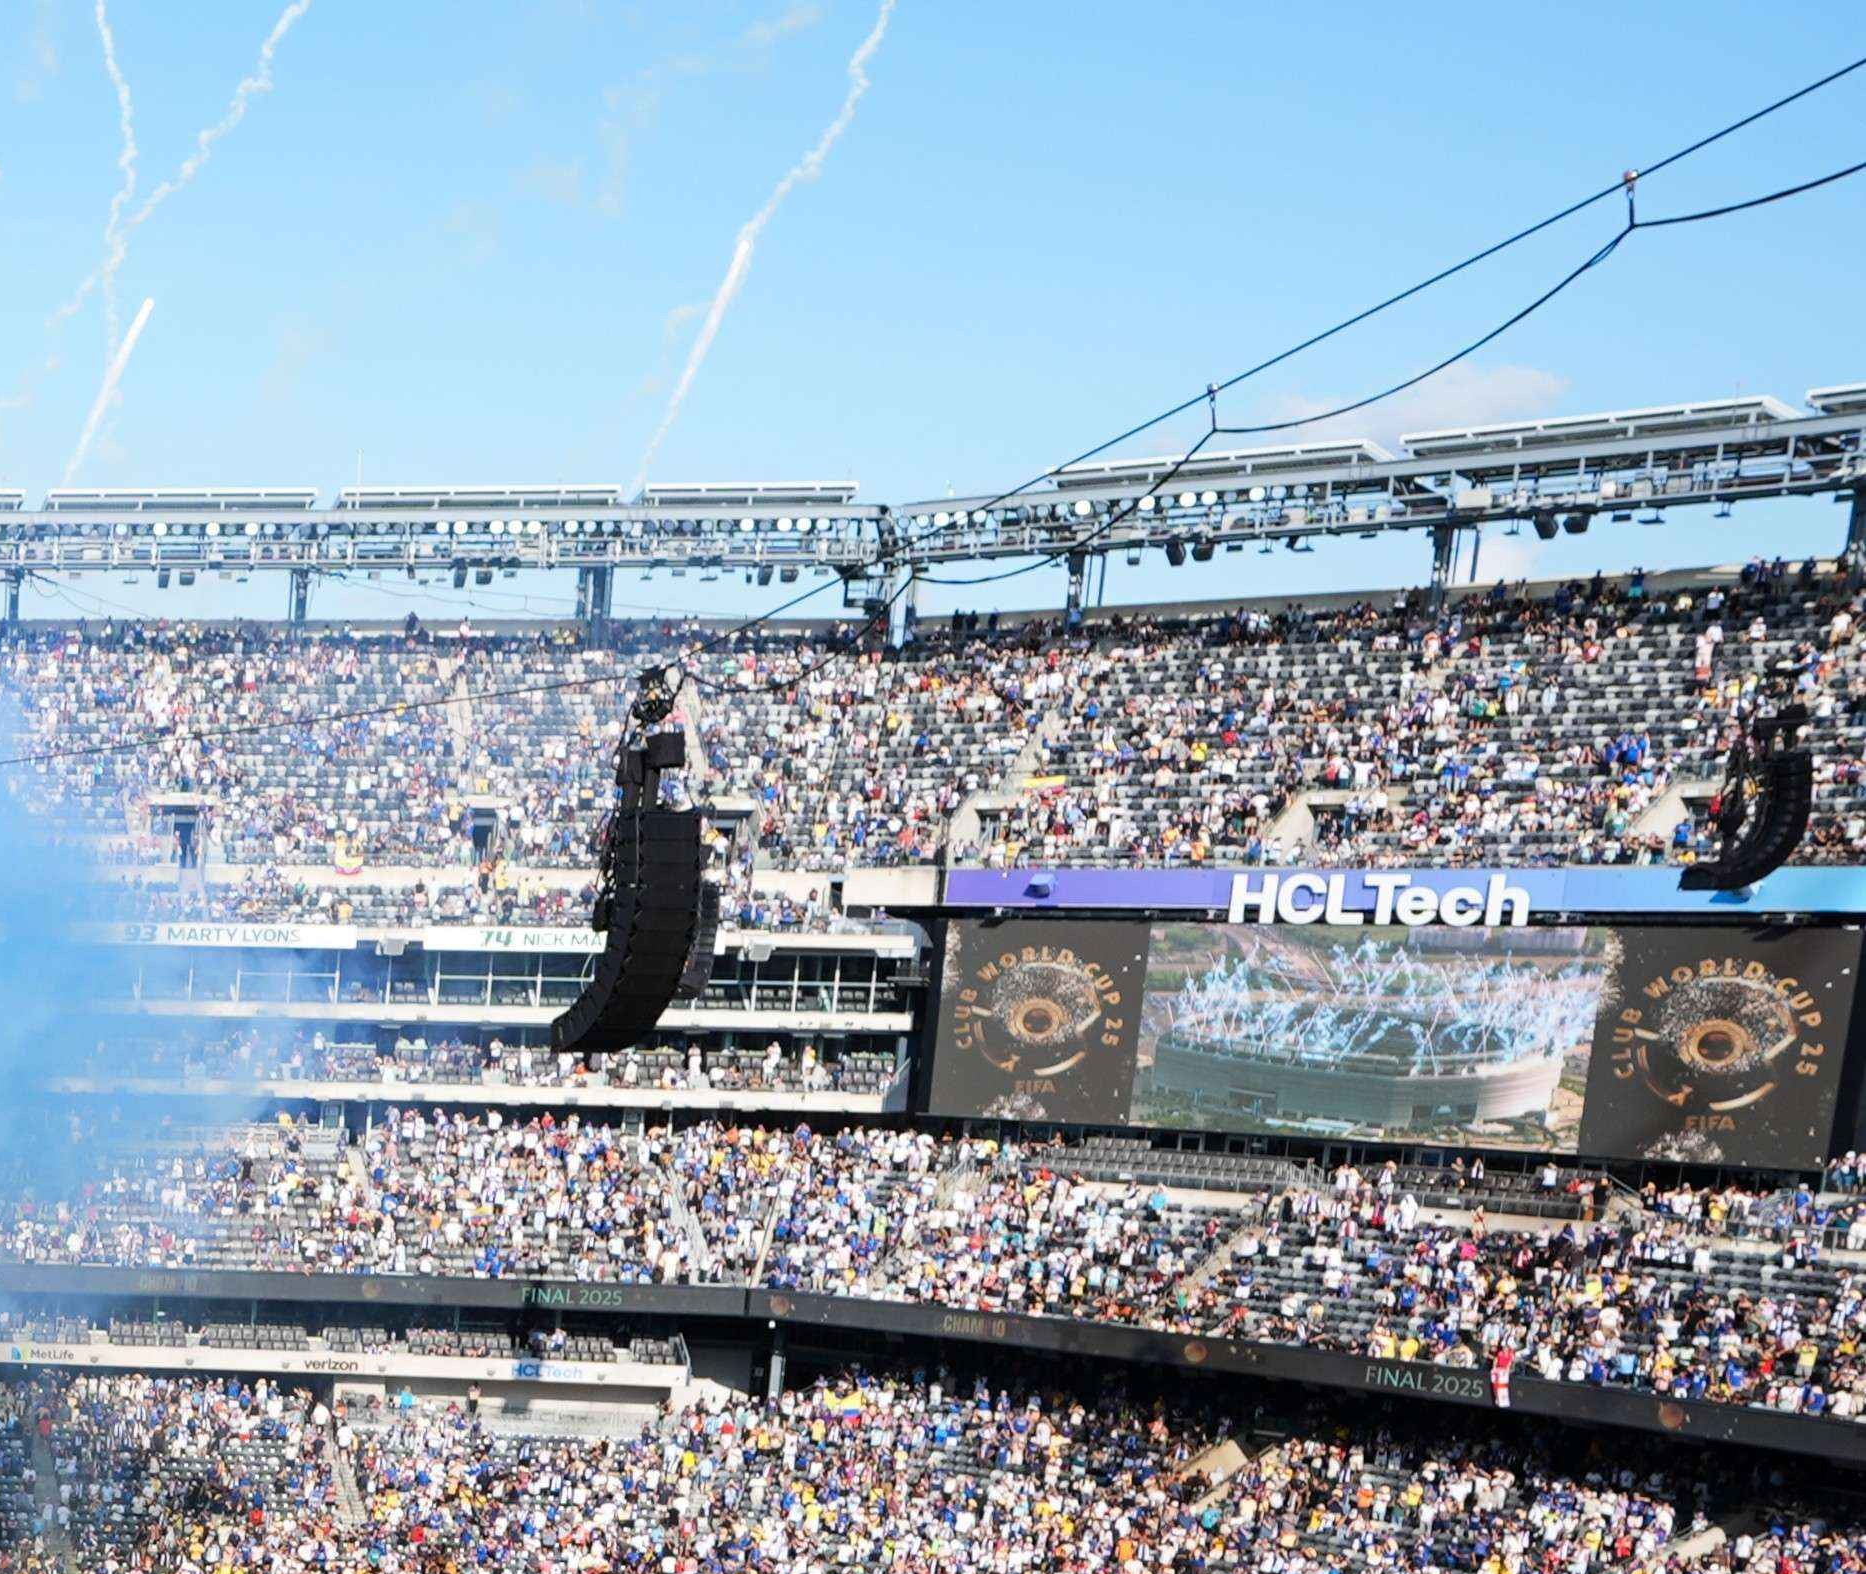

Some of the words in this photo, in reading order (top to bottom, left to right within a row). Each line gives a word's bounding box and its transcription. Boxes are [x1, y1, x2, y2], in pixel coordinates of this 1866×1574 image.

[1229, 873, 1531, 927] HCLTech
[168, 928, 236, 941] MARTY
[243, 928, 301, 942] LYONS
[524, 934, 565, 947] NICK
[976, 946, 1074, 982] WORLD
[1084, 963, 1121, 1004] CUP
[1643, 958, 1765, 998] WORLD
[1775, 977, 1822, 1026] CUP
[1685, 1115, 1736, 1131] FIFA
[521, 1287, 573, 1303] FINAL
[579, 1289, 622, 1306] 2025
[30, 1349, 75, 1360] MetLife
[304, 1358, 359, 1371] verizon
[1365, 1366, 1427, 1391] FINAL
[1432, 1373, 1484, 1398] 2025
